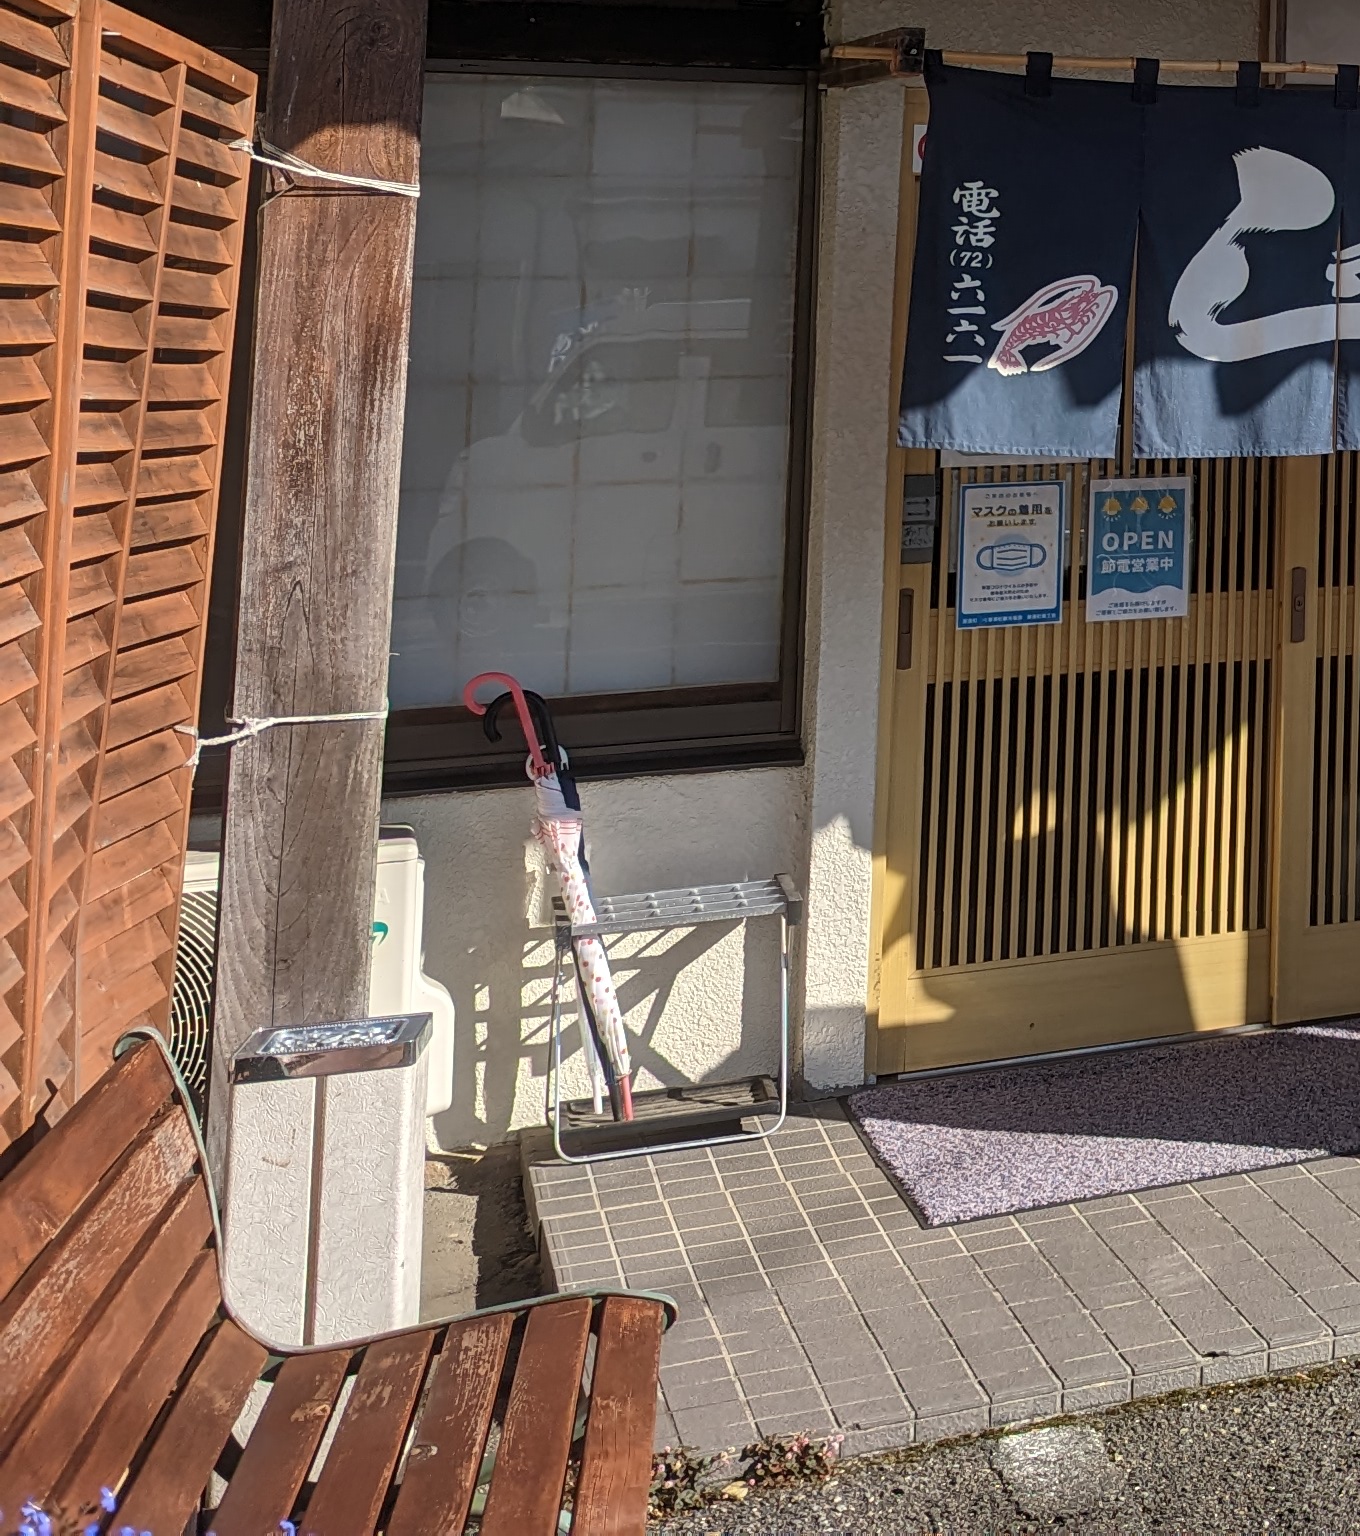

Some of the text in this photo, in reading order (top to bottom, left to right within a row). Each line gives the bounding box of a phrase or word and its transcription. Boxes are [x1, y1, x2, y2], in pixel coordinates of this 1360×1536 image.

[1101, 530, 1174, 552] OPEN
[1100, 556, 1174, 574] 節電営業中
